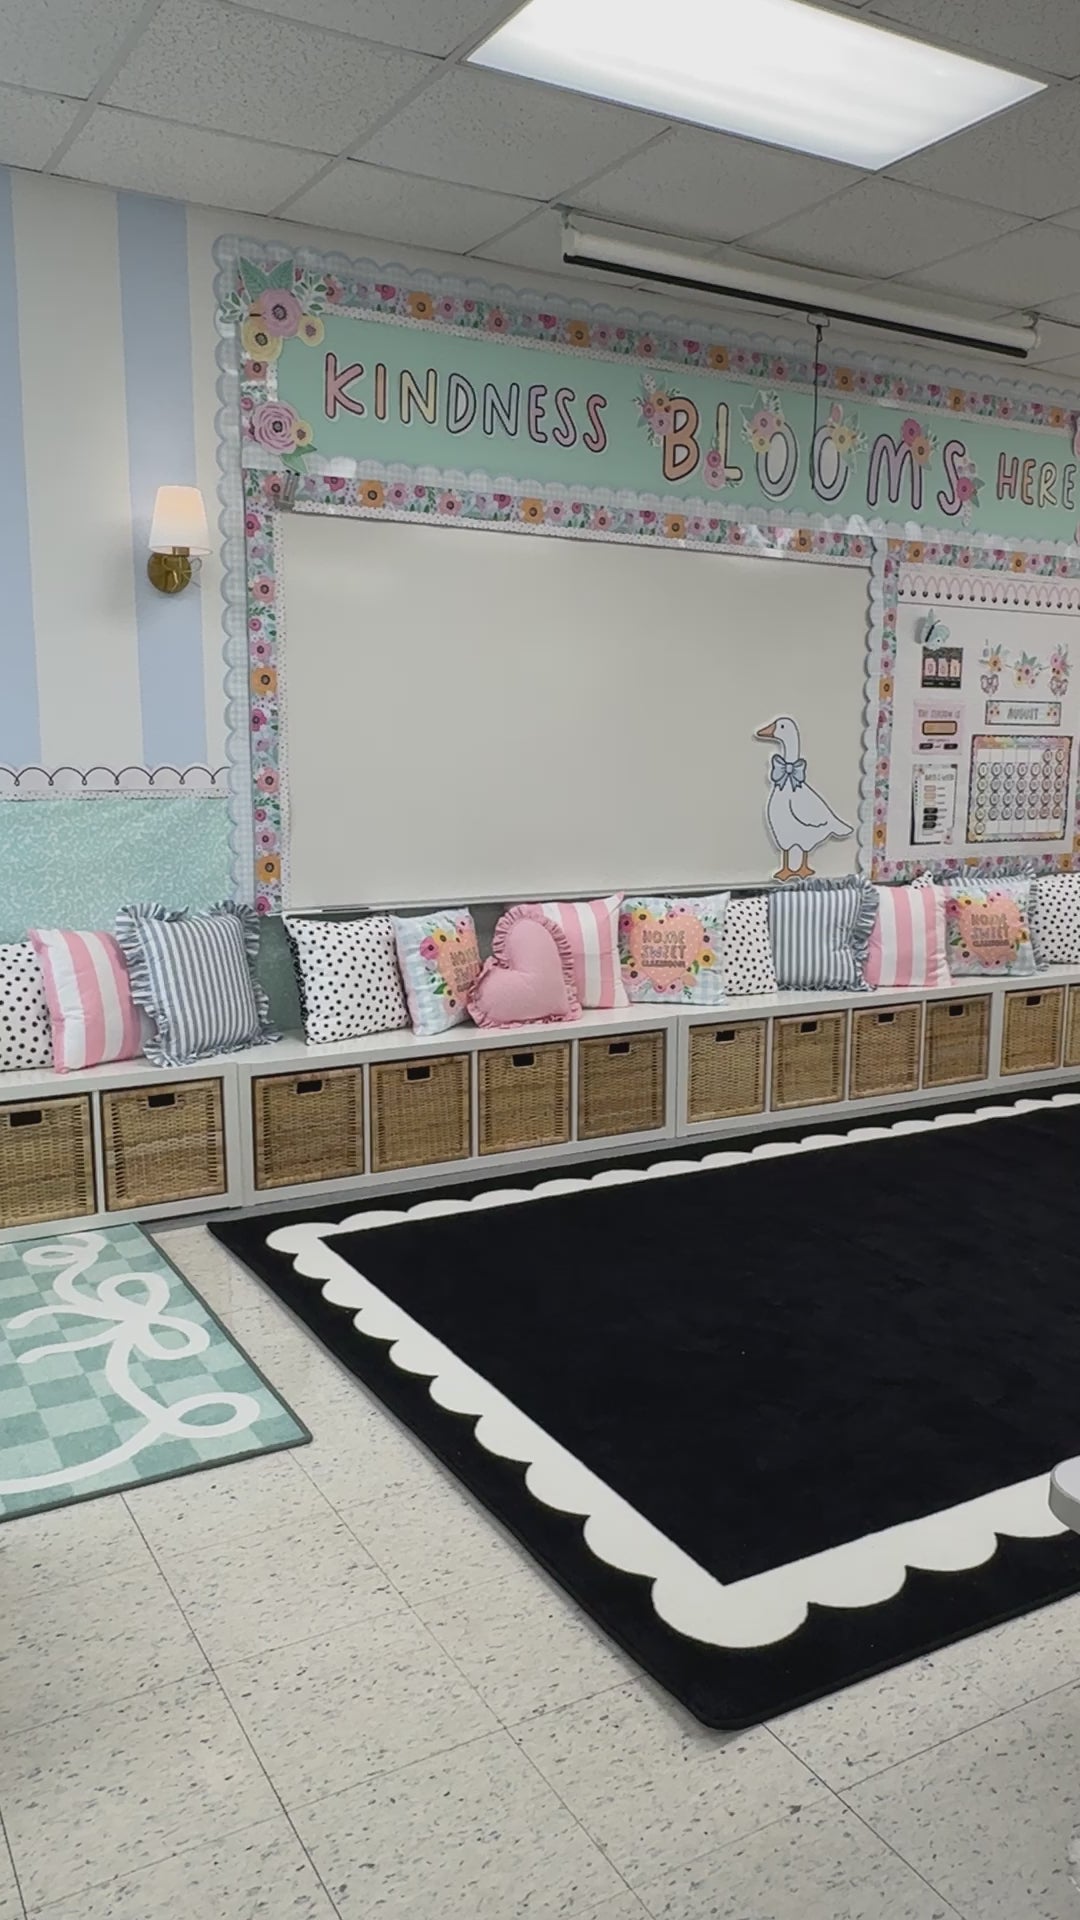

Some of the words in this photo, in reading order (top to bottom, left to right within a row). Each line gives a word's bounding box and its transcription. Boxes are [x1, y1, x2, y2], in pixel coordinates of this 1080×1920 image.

[324, 352, 608, 454] KINDNESS
[661, 395, 967, 517] BLOOMS
[996, 451, 1078, 511] HERE
[642, 929, 686, 945] HOME
[641, 944, 687, 960] SWEET
